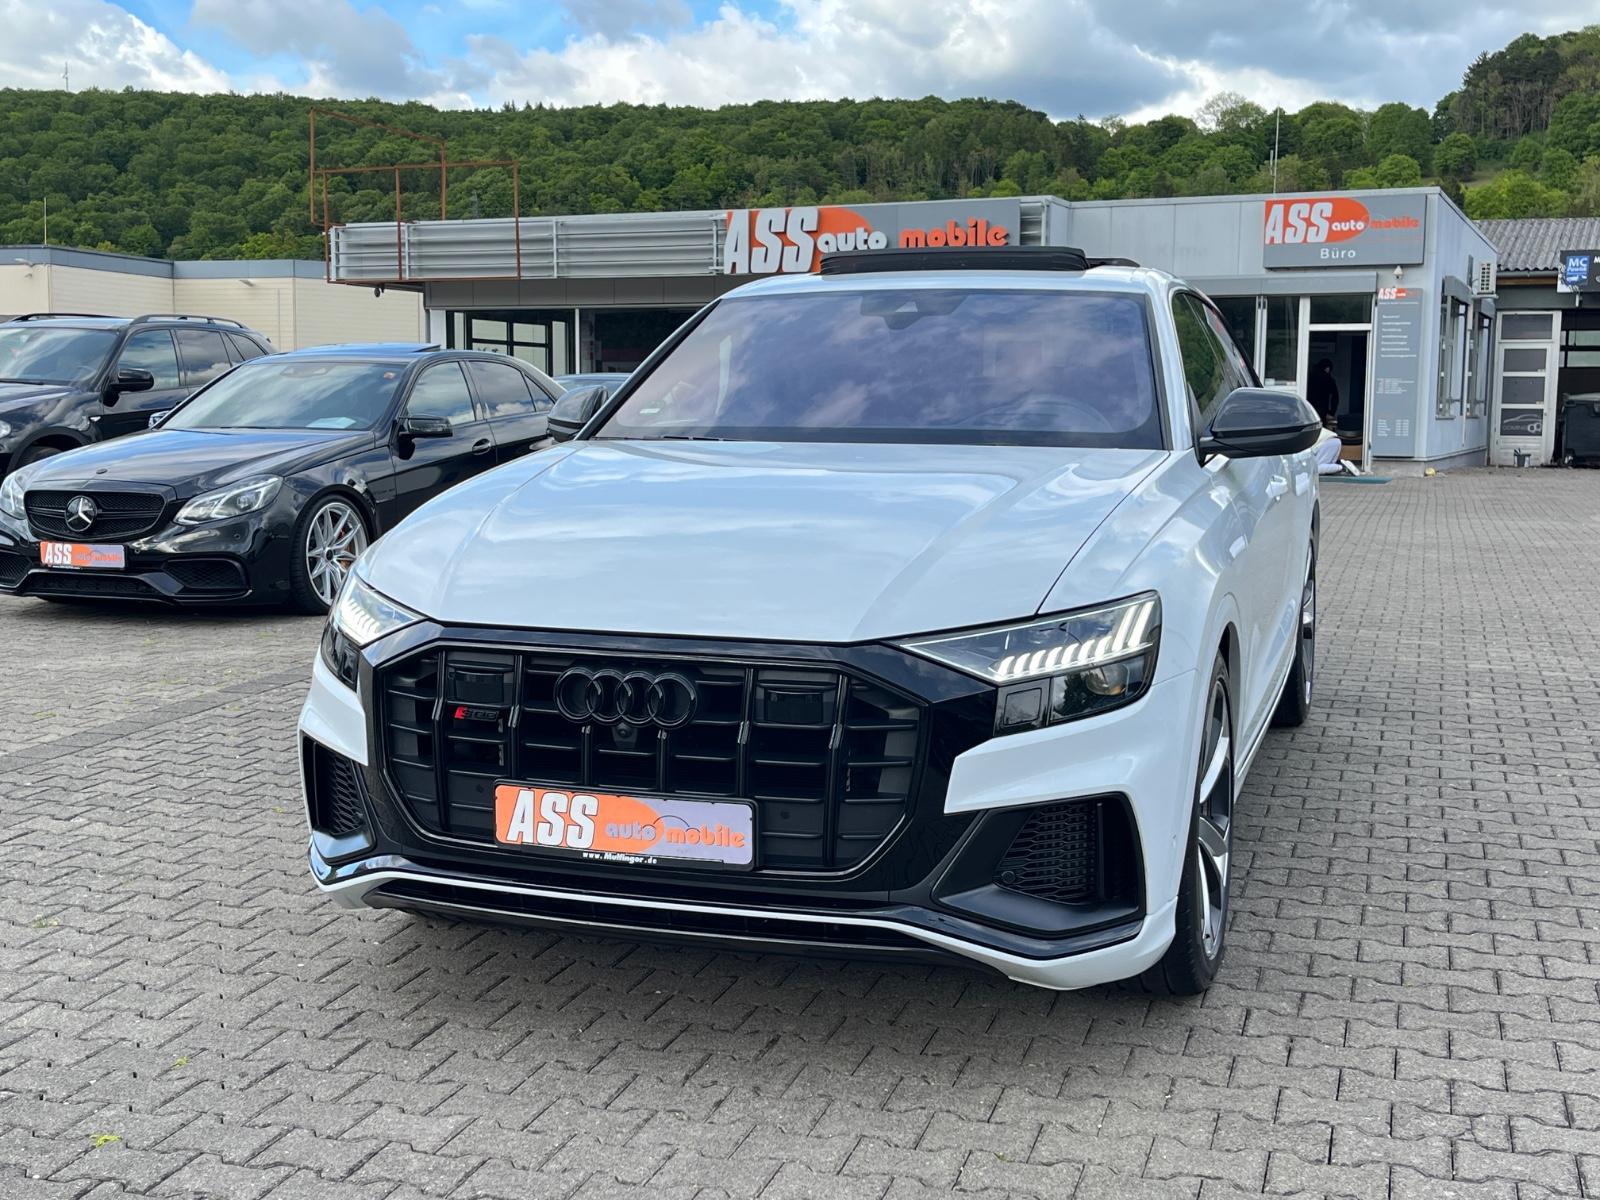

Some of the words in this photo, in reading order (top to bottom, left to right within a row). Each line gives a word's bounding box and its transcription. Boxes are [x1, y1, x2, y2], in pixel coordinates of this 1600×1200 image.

[1265, 202, 1333, 244] ASS
[1331, 219, 1365, 231] auto
[723, 206, 818, 274] ASS
[816, 227, 888, 253] auto
[899, 218, 1009, 248] mobile
[1320, 248, 1356, 260] Büro
[1568, 257, 1588, 267] MC
[1378, 288, 1397, 300] ASS
[45, 543, 72, 565] ASS
[506, 789, 599, 849] ASS
[605, 821, 657, 841] auto
[665, 825, 745, 848] mobile
